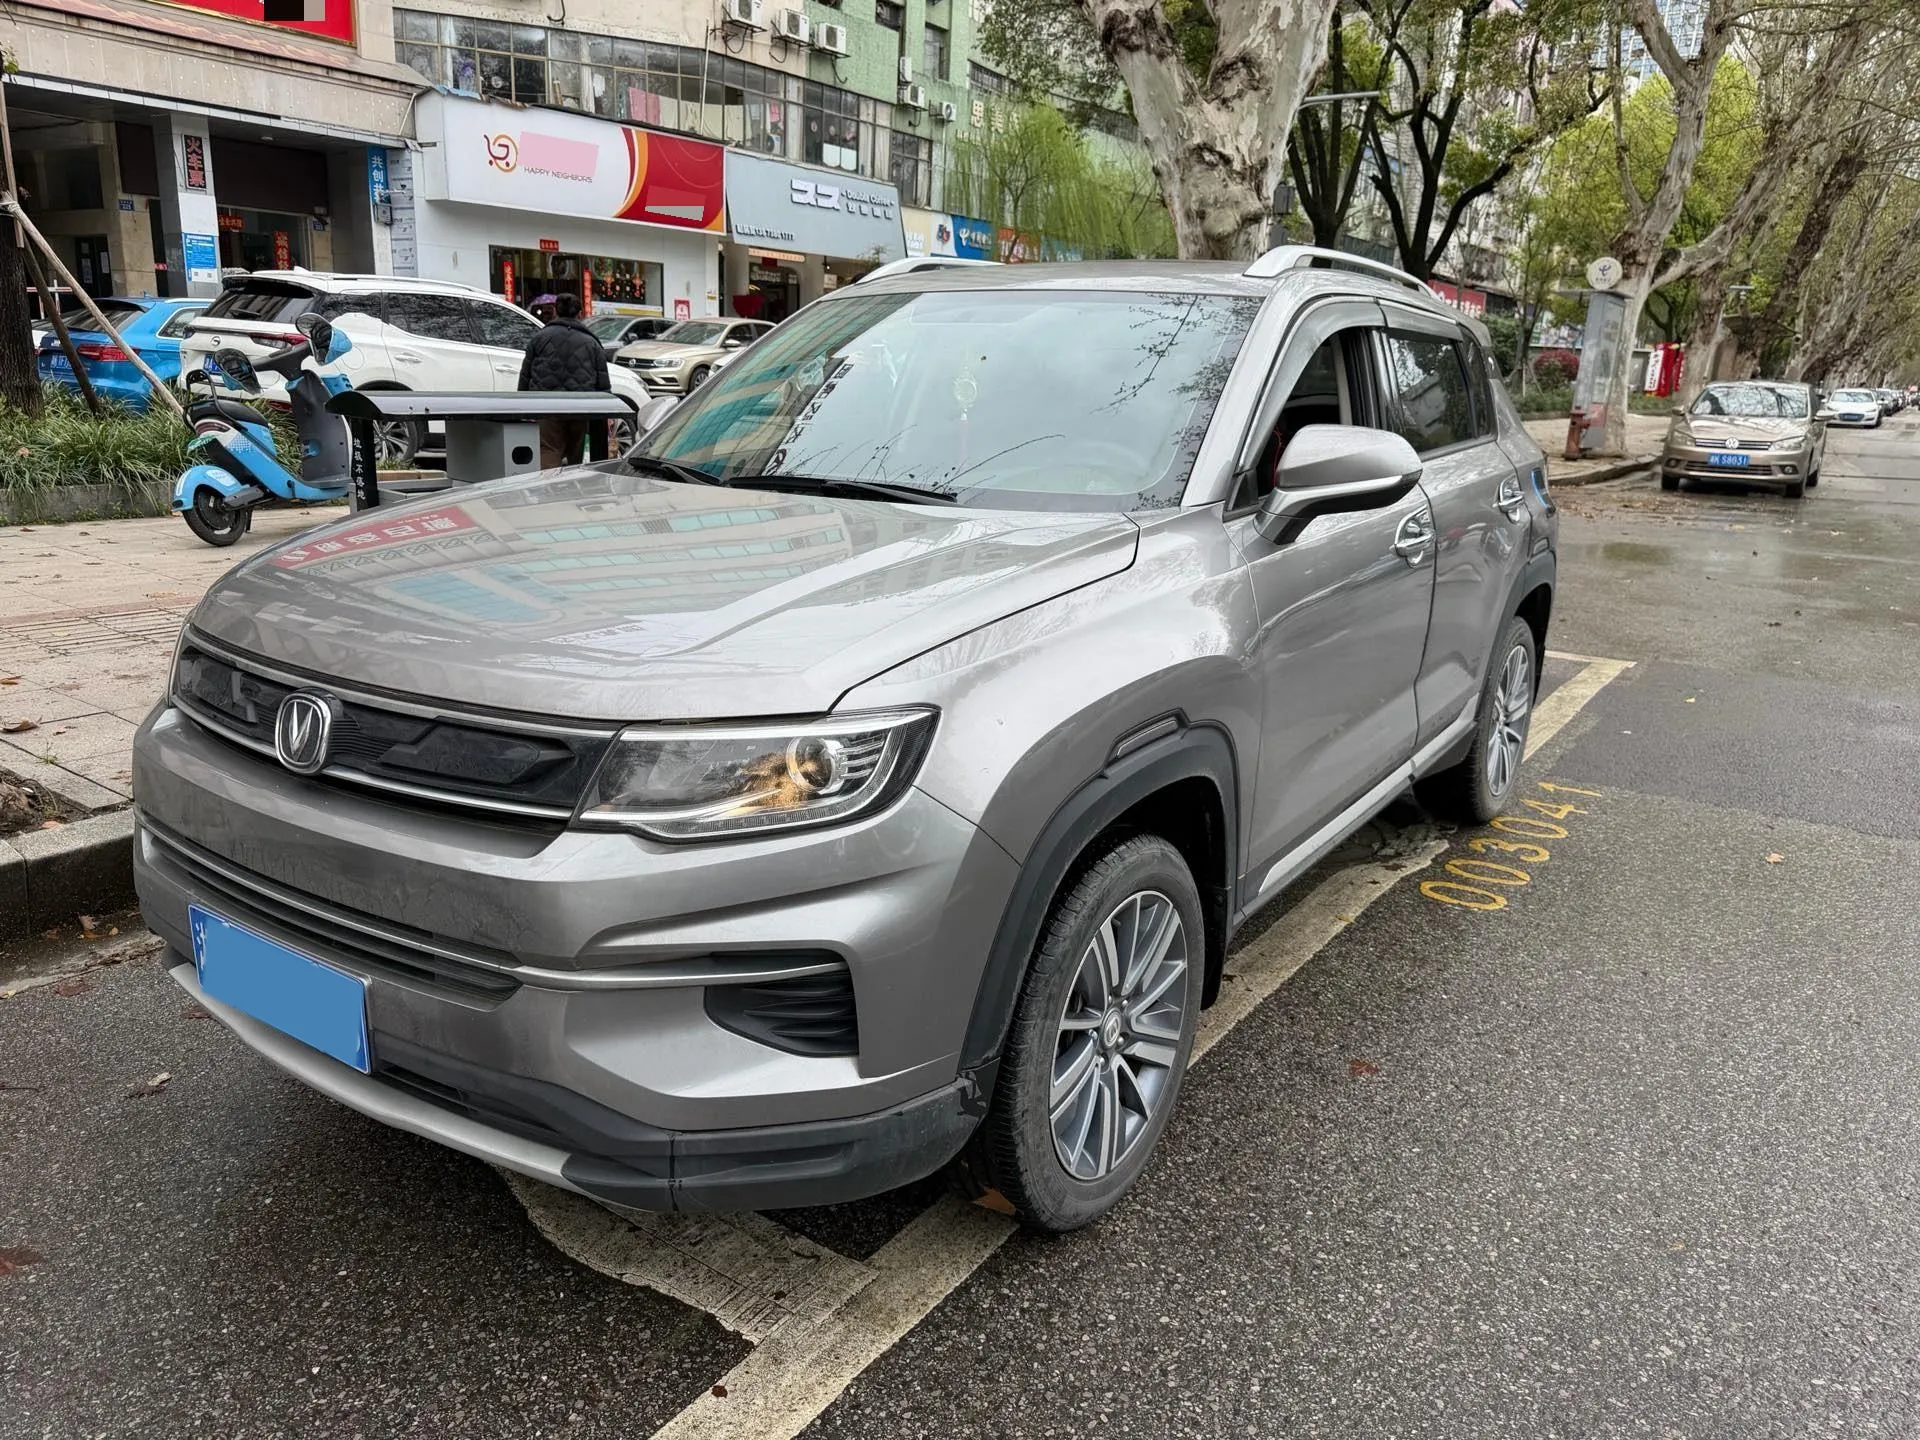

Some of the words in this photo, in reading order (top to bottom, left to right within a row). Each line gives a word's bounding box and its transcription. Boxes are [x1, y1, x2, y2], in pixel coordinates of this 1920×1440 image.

[187, 137, 205, 187] 火车票
[523, 166, 550, 177] HAPPY
[551, 171, 593, 184] NEIGHBORS
[353, 437, 366, 500] 垃圾不落地
[1419, 781, 1602, 911] 003041
